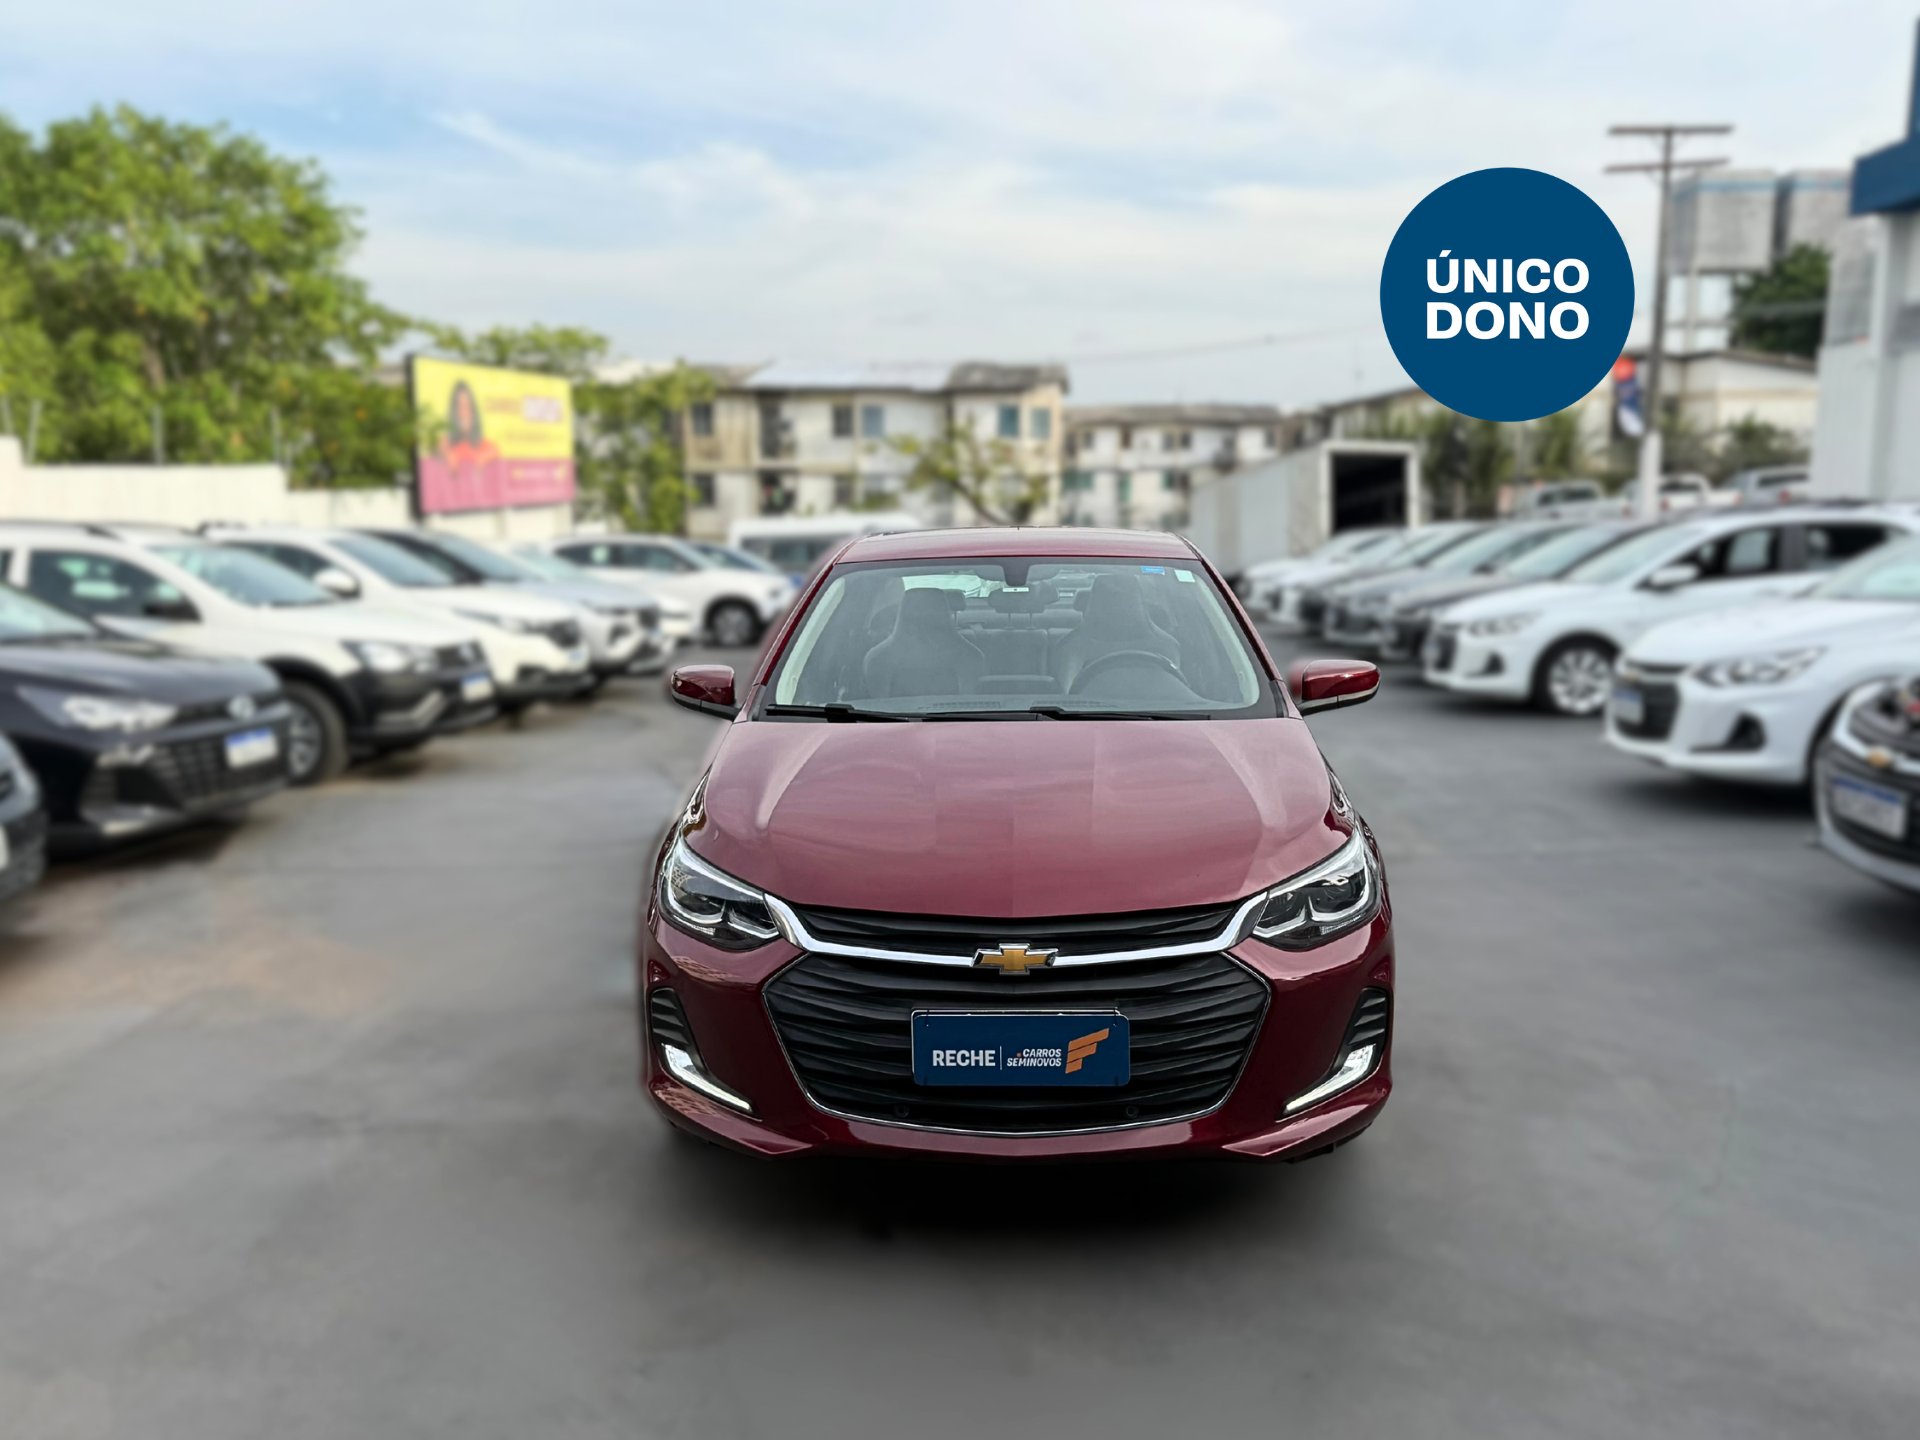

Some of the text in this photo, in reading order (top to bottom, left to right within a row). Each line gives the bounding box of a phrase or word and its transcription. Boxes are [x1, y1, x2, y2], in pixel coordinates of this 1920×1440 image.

[1022, 1048, 1062, 1058] CARROS
[932, 1050, 996, 1067] RECHE
[1006, 1057, 1062, 1067] SEMINOVOS
